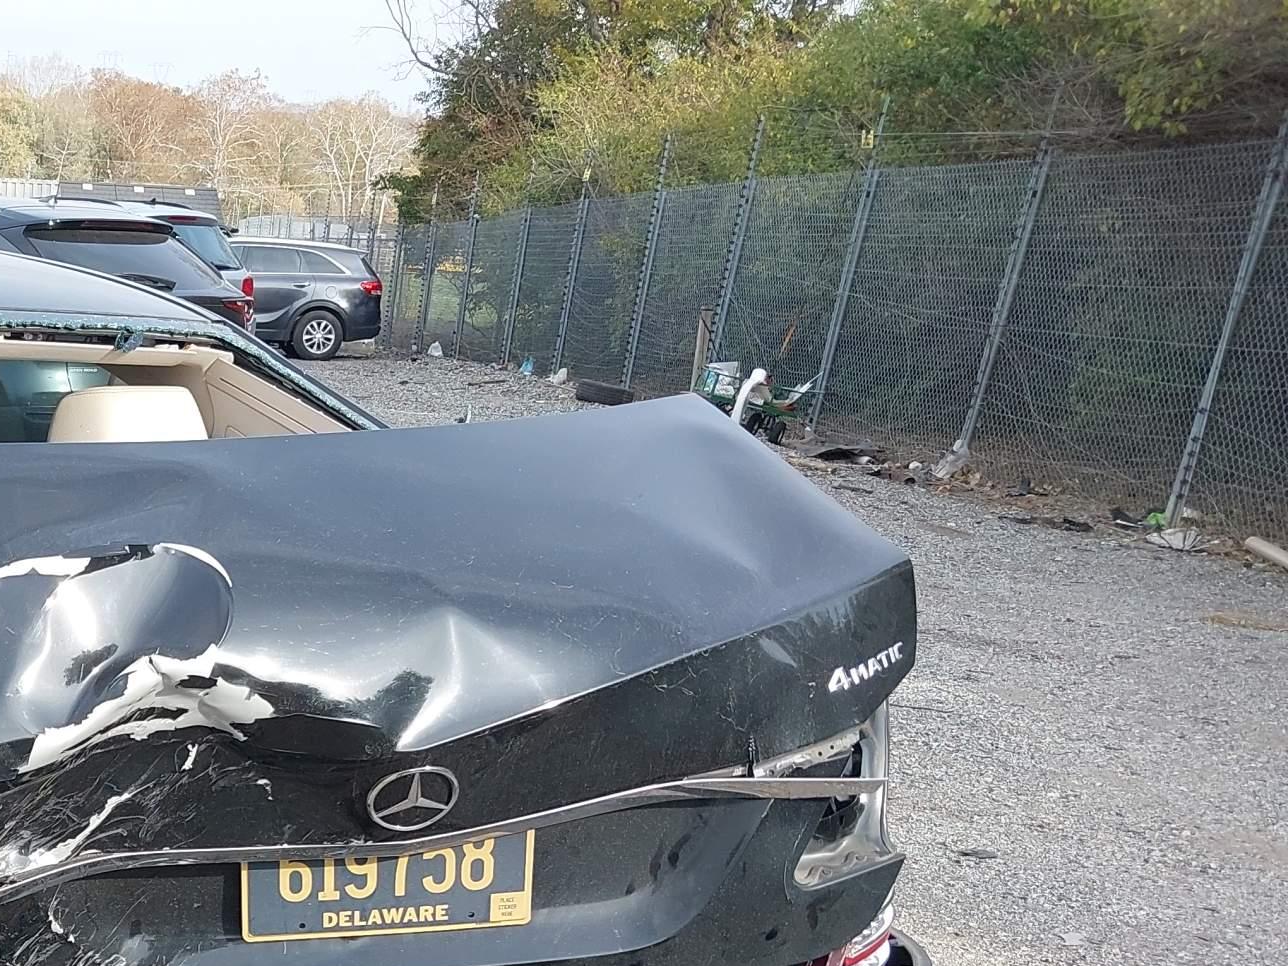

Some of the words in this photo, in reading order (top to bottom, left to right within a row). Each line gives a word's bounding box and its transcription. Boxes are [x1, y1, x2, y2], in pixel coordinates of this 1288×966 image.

[827, 641, 904, 693] 4MATIC
[278, 837, 496, 903] 619758
[323, 904, 449, 929] DELAWARE
